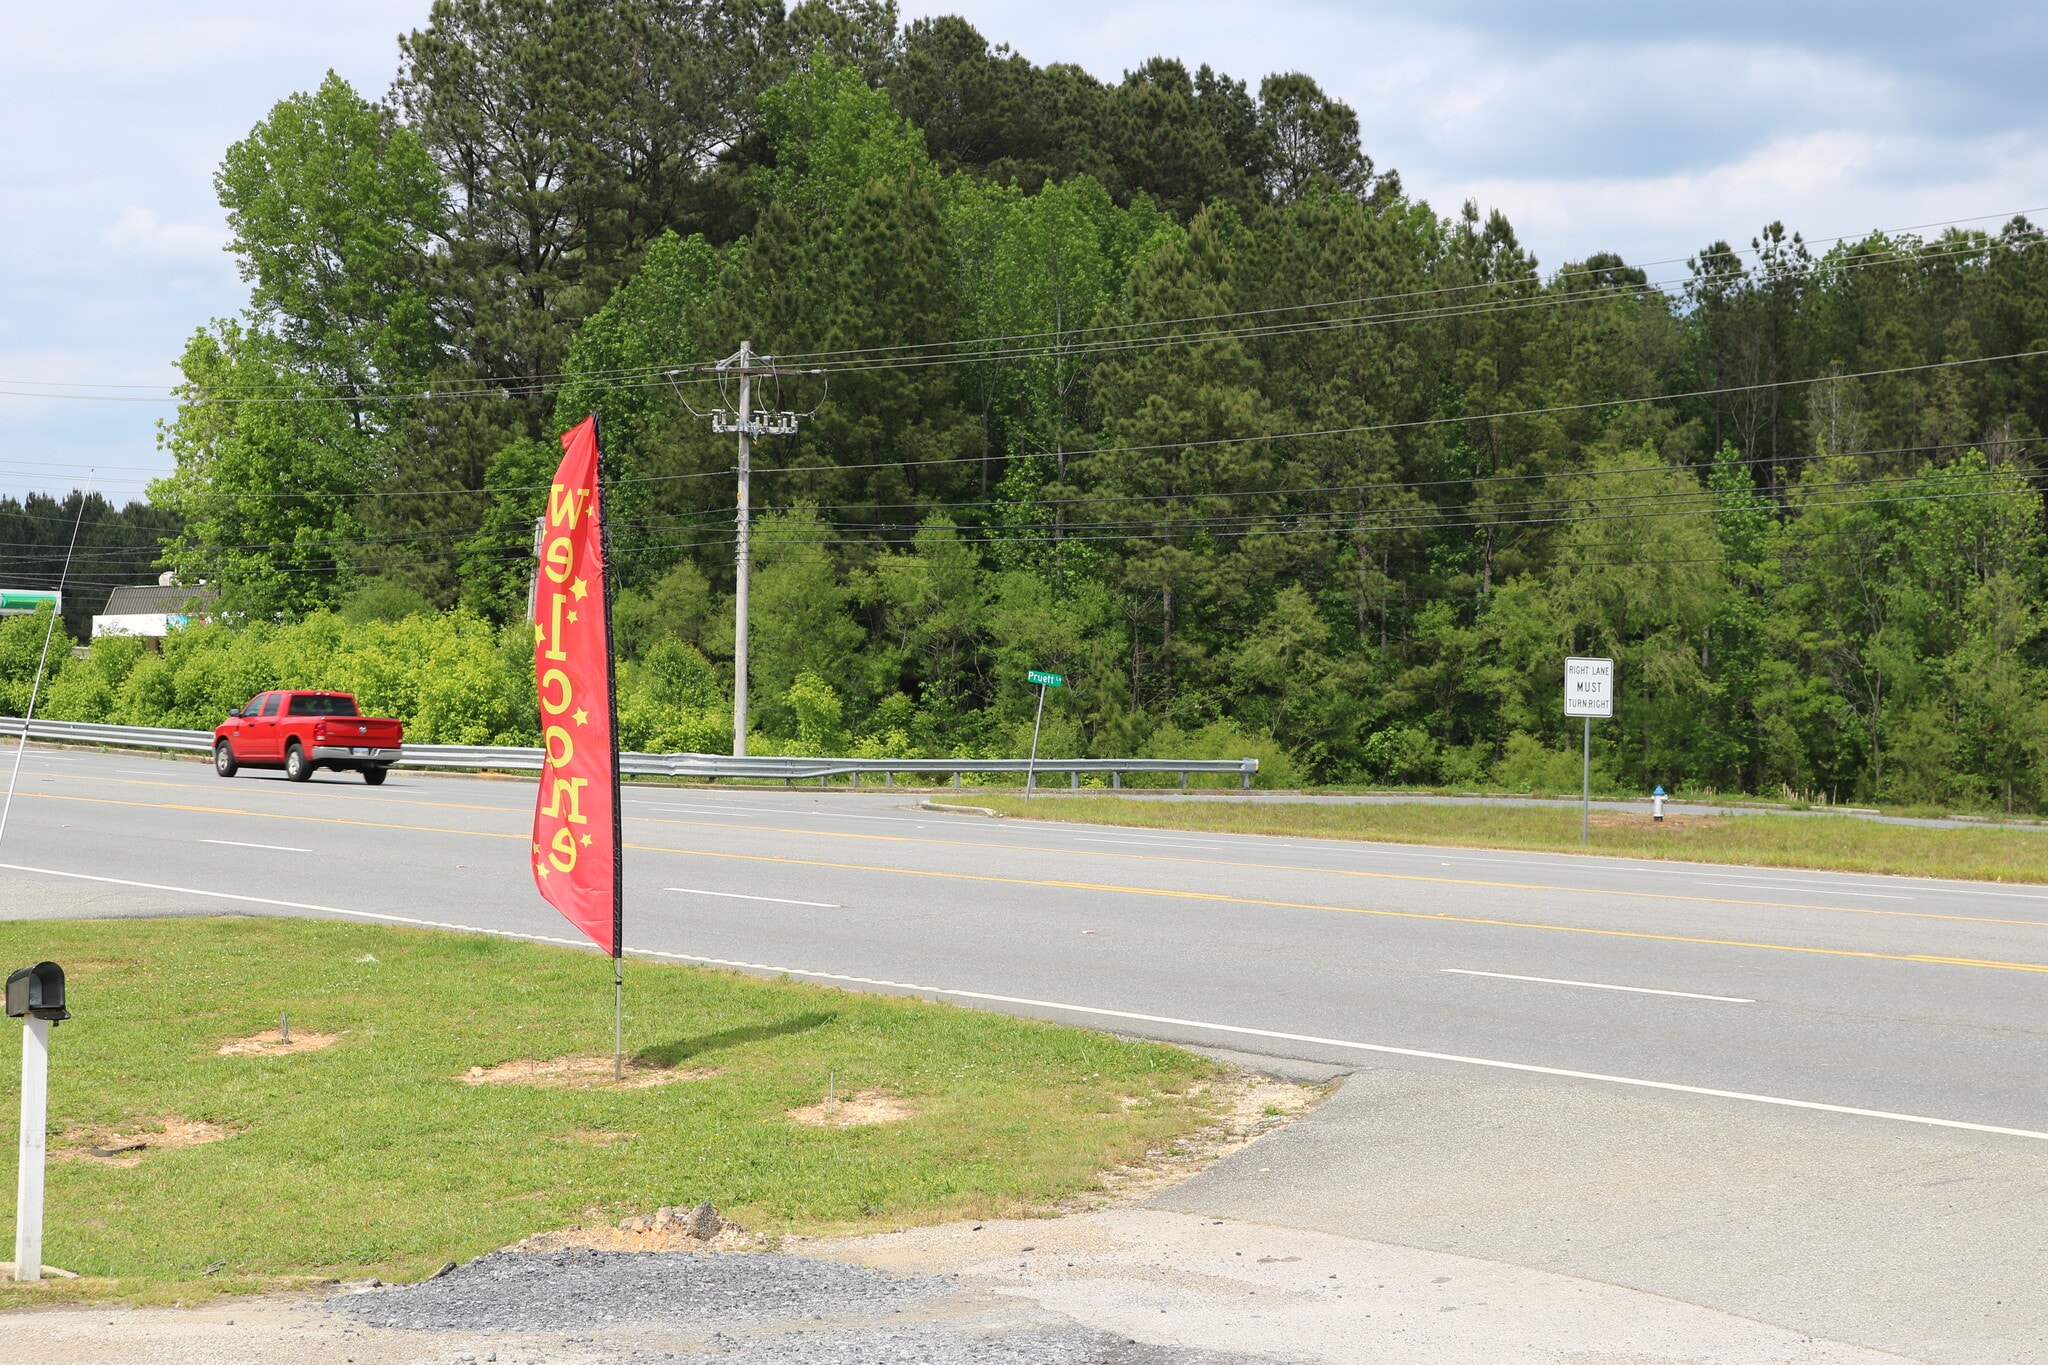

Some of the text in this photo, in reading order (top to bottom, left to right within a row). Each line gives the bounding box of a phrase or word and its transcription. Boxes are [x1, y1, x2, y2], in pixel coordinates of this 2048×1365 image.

[1569, 665, 1609, 676] RIGHT LANE
[1028, 671, 1054, 684] Pruett
[1577, 682, 1602, 693] MUST
[1568, 699, 1609, 709] TURN RIGHT
